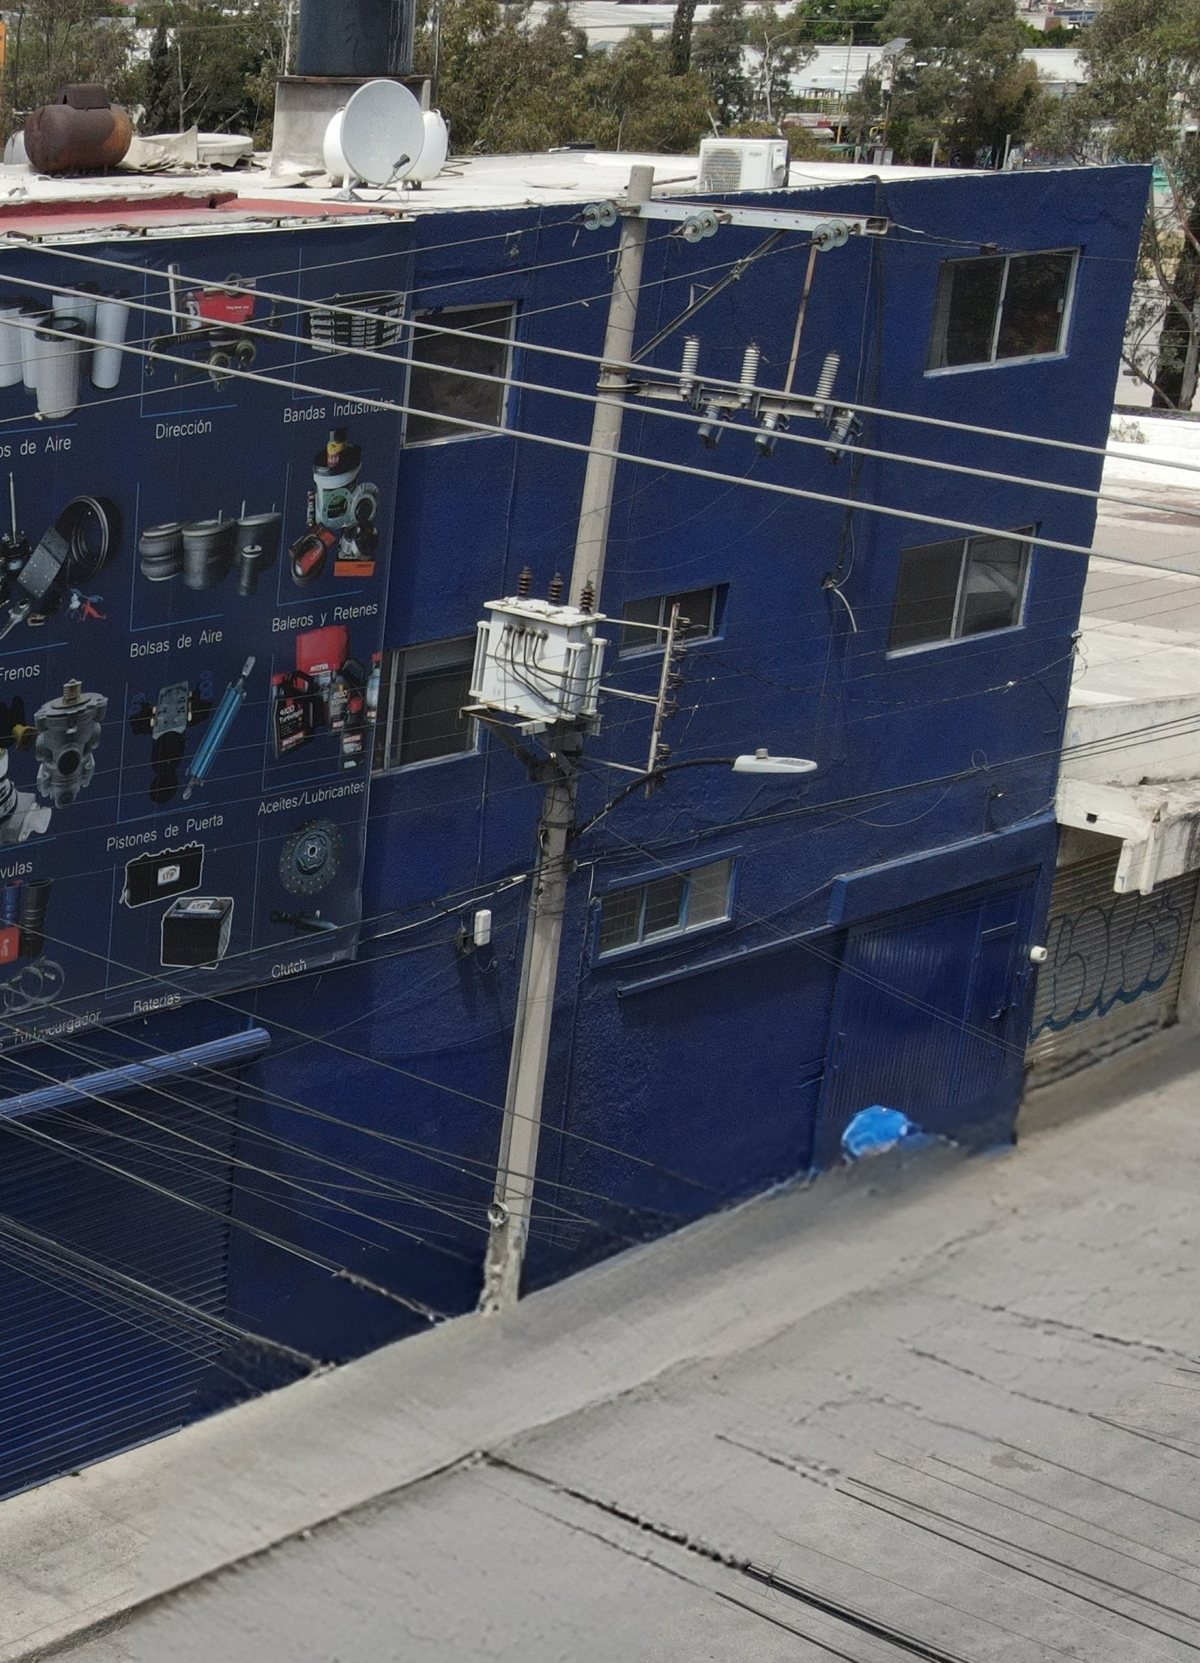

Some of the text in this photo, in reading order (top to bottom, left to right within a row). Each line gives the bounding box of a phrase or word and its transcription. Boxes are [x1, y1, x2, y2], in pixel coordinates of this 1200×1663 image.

[283, 404, 327, 424] Bandas
[155, 419, 212, 440] Dirección
[20, 439, 37, 456] de
[44, 436, 72, 453] Aire
[272, 602, 378, 633] Baleros y Retenes
[129, 628, 223, 659] Bolsas de Aire
[257, 781, 365, 817] Aceites/Lubricantes
[106, 813, 224, 852] Pistones de Puerta
[271, 958, 307, 979] Clutch
